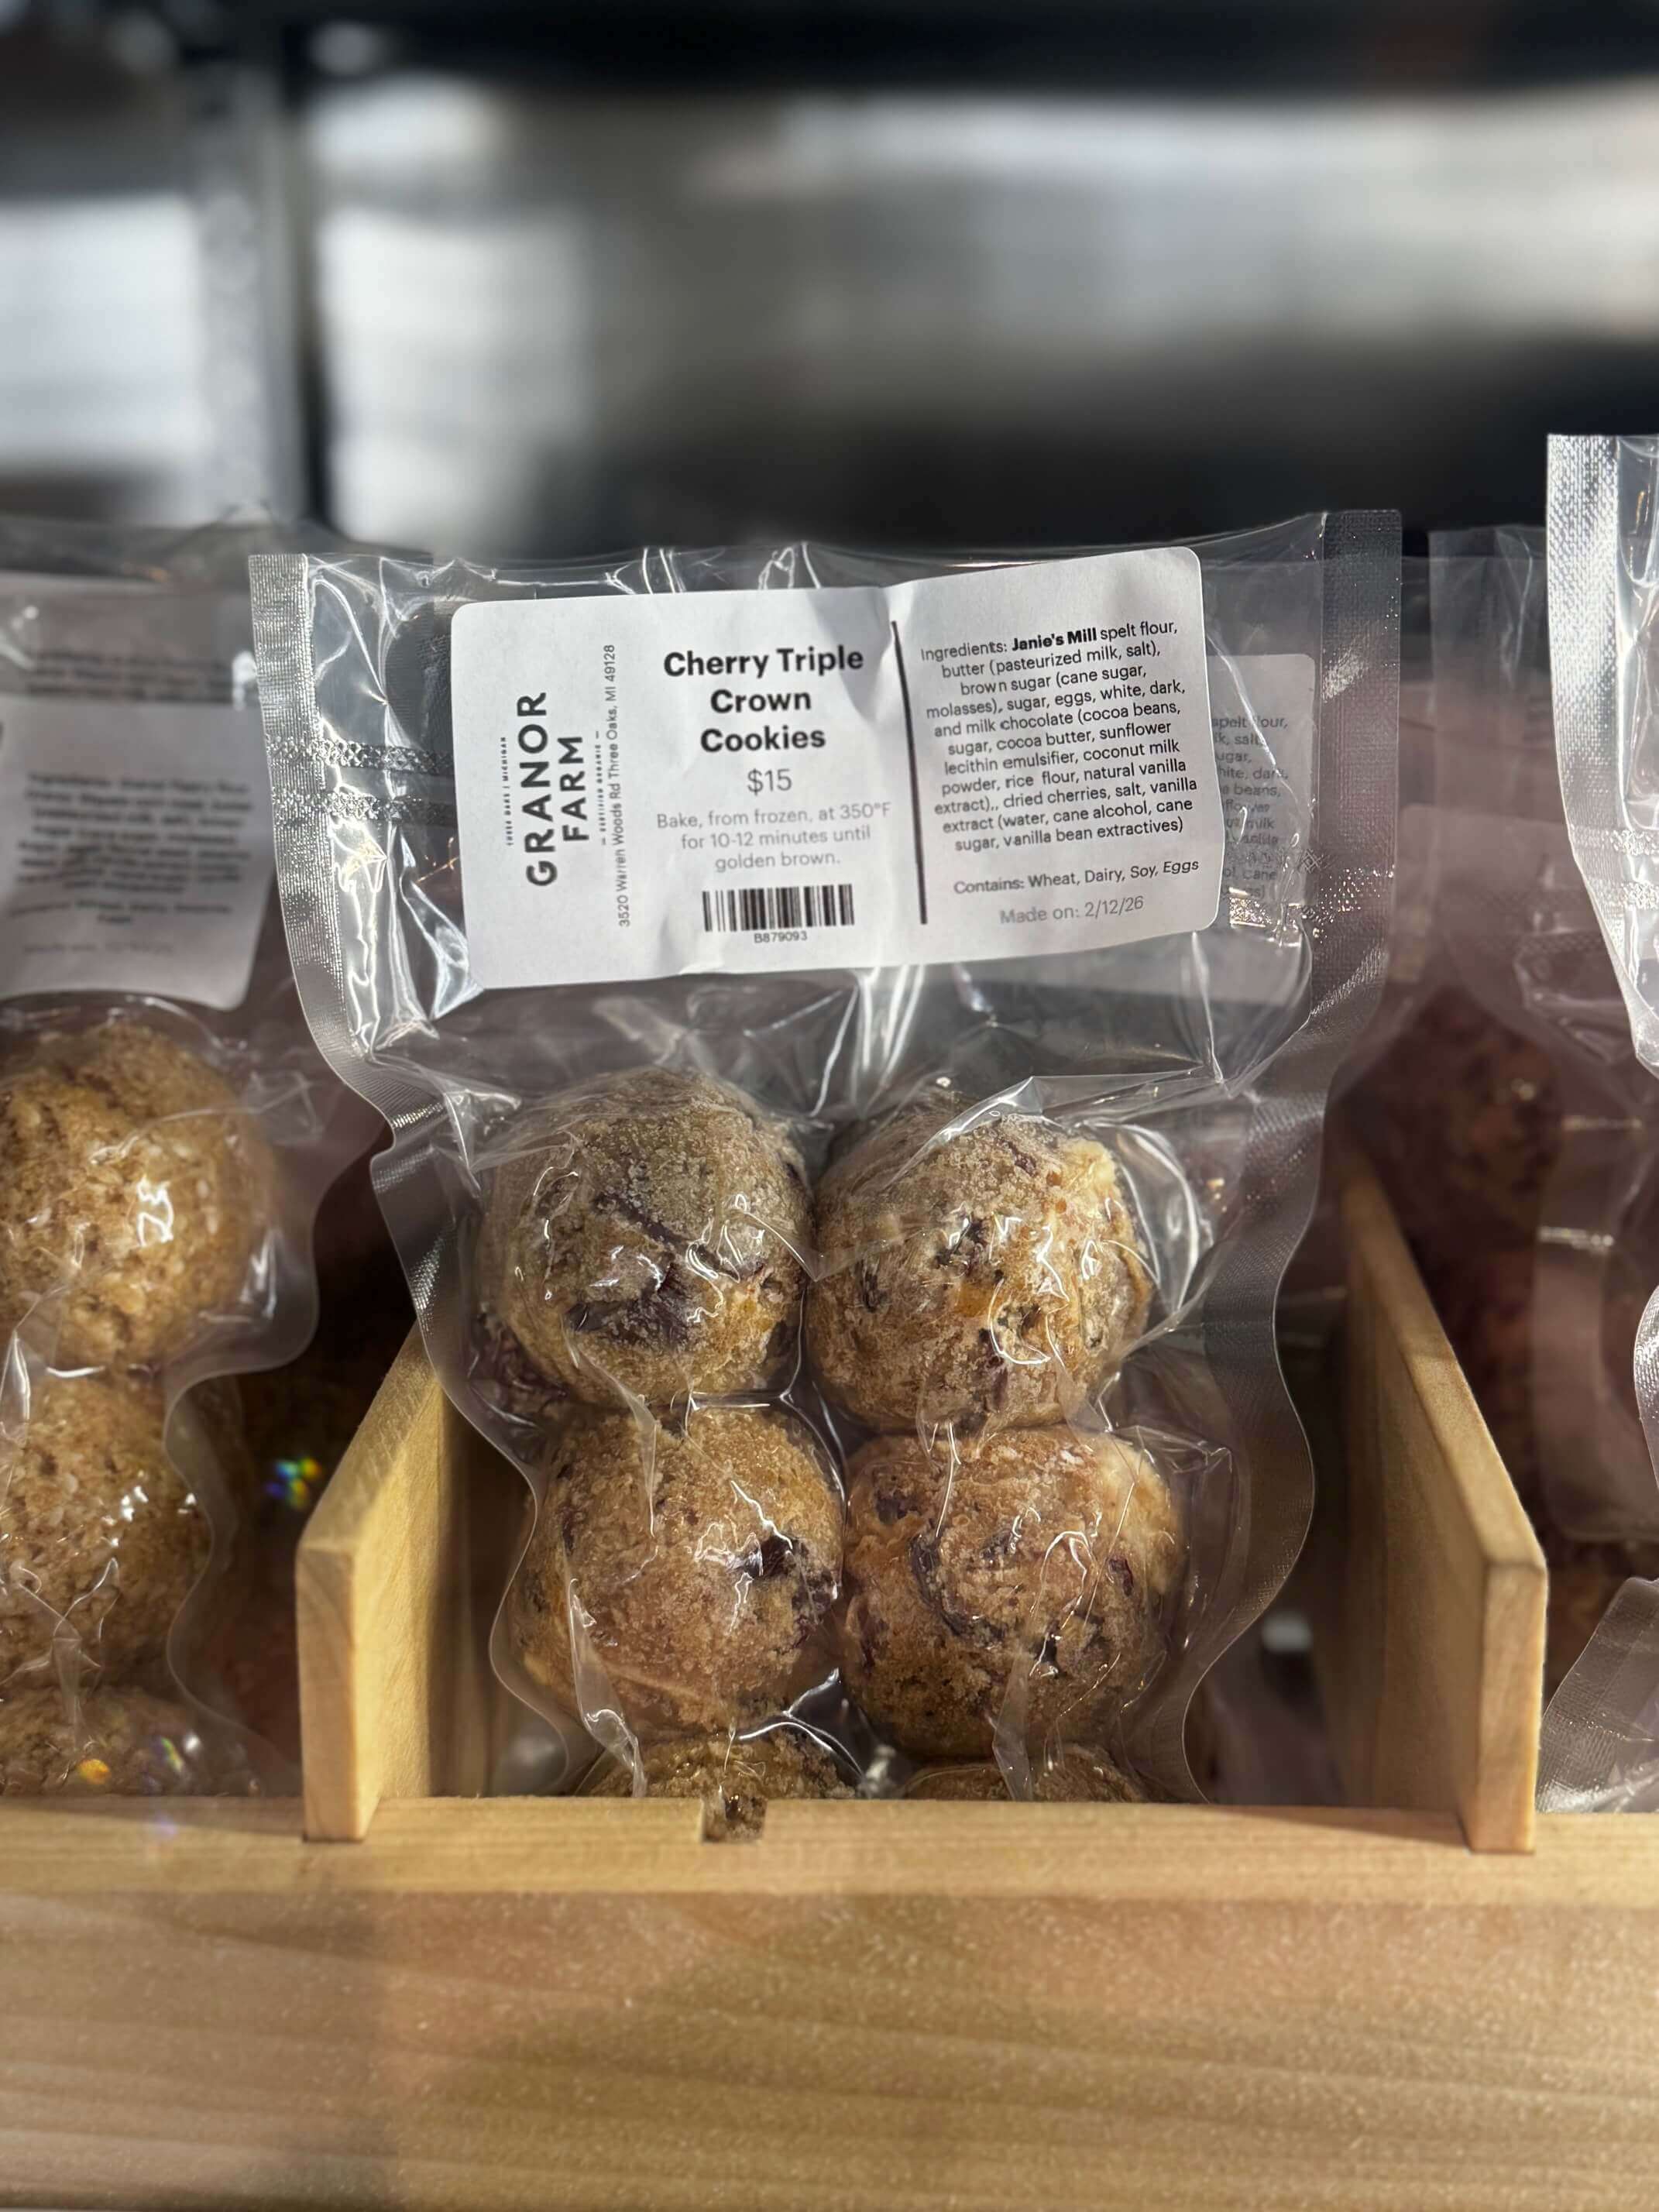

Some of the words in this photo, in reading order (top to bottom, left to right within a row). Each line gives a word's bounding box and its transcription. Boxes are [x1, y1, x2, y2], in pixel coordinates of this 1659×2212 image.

[921, 641, 1008, 662] Ingredients:
[1012, 634, 1064, 651] Janie's
[1067, 627, 1097, 644] Mill
[1101, 623, 1136, 642] spelt
[1140, 620, 1177, 636] flour,
[603, 644, 616, 682] 49128
[664, 650, 769, 679] Cherry
[777, 644, 864, 676] Triple
[942, 662, 984, 678] butter
[989, 649, 1081, 675] (pasteurized
[1087, 645, 1121, 661] milk,
[1126, 640, 1160, 657] salt),
[605, 686, 617, 702] MI
[960, 682, 1008, 696] brown
[1011, 675, 1051, 692] sugar
[1056, 669, 1097, 689] (cane
[1102, 664, 1146, 680] sugar,
[710, 689, 812, 714] Crown
[926, 699, 1004, 719] molasses),
[1007, 696, 1050, 713] sugar,
[1055, 691, 1096, 707] eggs,
[1100, 684, 1145, 701] white,
[1149, 678, 1185, 695] dark,
[606, 705, 618, 740] Oaks,
[934, 721, 961, 737] and
[967, 719, 996, 734] milk
[1000, 712, 1073, 731] chocolate
[1077, 706, 1128, 724] (cocoa
[1133, 700, 1180, 716] beans,
[700, 725, 826, 753] Cookies
[945, 757, 998, 775] lecithin
[1003, 750, 1078, 770] emulsifier,
[1084, 744, 1145, 761] coconut
[1149, 738, 1180, 754] milk
[948, 741, 992, 757] sugar,
[996, 737, 1042, 750] cocoa
[1046, 729, 1095, 745] butter,
[1099, 722, 1171, 740] sunflower
[608, 744, 620, 779] Three
[942, 778, 1000, 798] powder,
[1005, 775, 1034, 788] rice
[1042, 771, 1079, 785] flour,
[1084, 763, 1135, 781] natural
[1139, 759, 1187, 775] vanilla
[517, 692, 558, 886] GRANOR
[558, 737, 589, 841] FARM
[609, 783, 620, 799] Rd
[747, 768, 792, 796] $15
[1003, 792, 1042, 809] dried
[1047, 786, 1111, 804] cherries,
[1115, 783, 1146, 797] salt,
[1150, 776, 1197, 795] vanilla
[610, 803, 625, 845] Woods
[658, 813, 702, 830] Bake,
[709, 810, 748, 825] from
[819, 807, 836, 819] at
[840, 802, 891, 819] 350°F
[943, 817, 994, 833] extract
[998, 811, 1049, 830] (water,
[1053, 808, 1089, 823] cane
[1094, 802, 1151, 819] alcohol,
[1156, 799, 1193, 812] cane
[682, 834, 704, 849] for
[711, 832, 754, 847] 10-12
[760, 830, 828, 845] minutes
[834, 825, 871, 841] until
[955, 837, 999, 853] sugar,
[1004, 830, 1051, 848] vanilla
[1056, 826, 1093, 841] bean
[1097, 816, 1183, 838] extractives)
[614, 849, 627, 891] Warren
[716, 854, 775, 873] golden
[781, 852, 840, 866] brown.
[954, 878, 1024, 894] Contains:
[1028, 872, 1080, 888] Wheat,
[1084, 867, 1125, 884] Dairy,
[1130, 865, 1158, 879] Soy,
[1163, 860, 1199, 874] Eggs
[617, 895, 630, 927] 3520
[1000, 907, 1047, 924] Made
[1053, 906, 1080, 920] on:
[1084, 895, 1143, 919] 2/12/26
[754, 930, 808, 943] B879093
